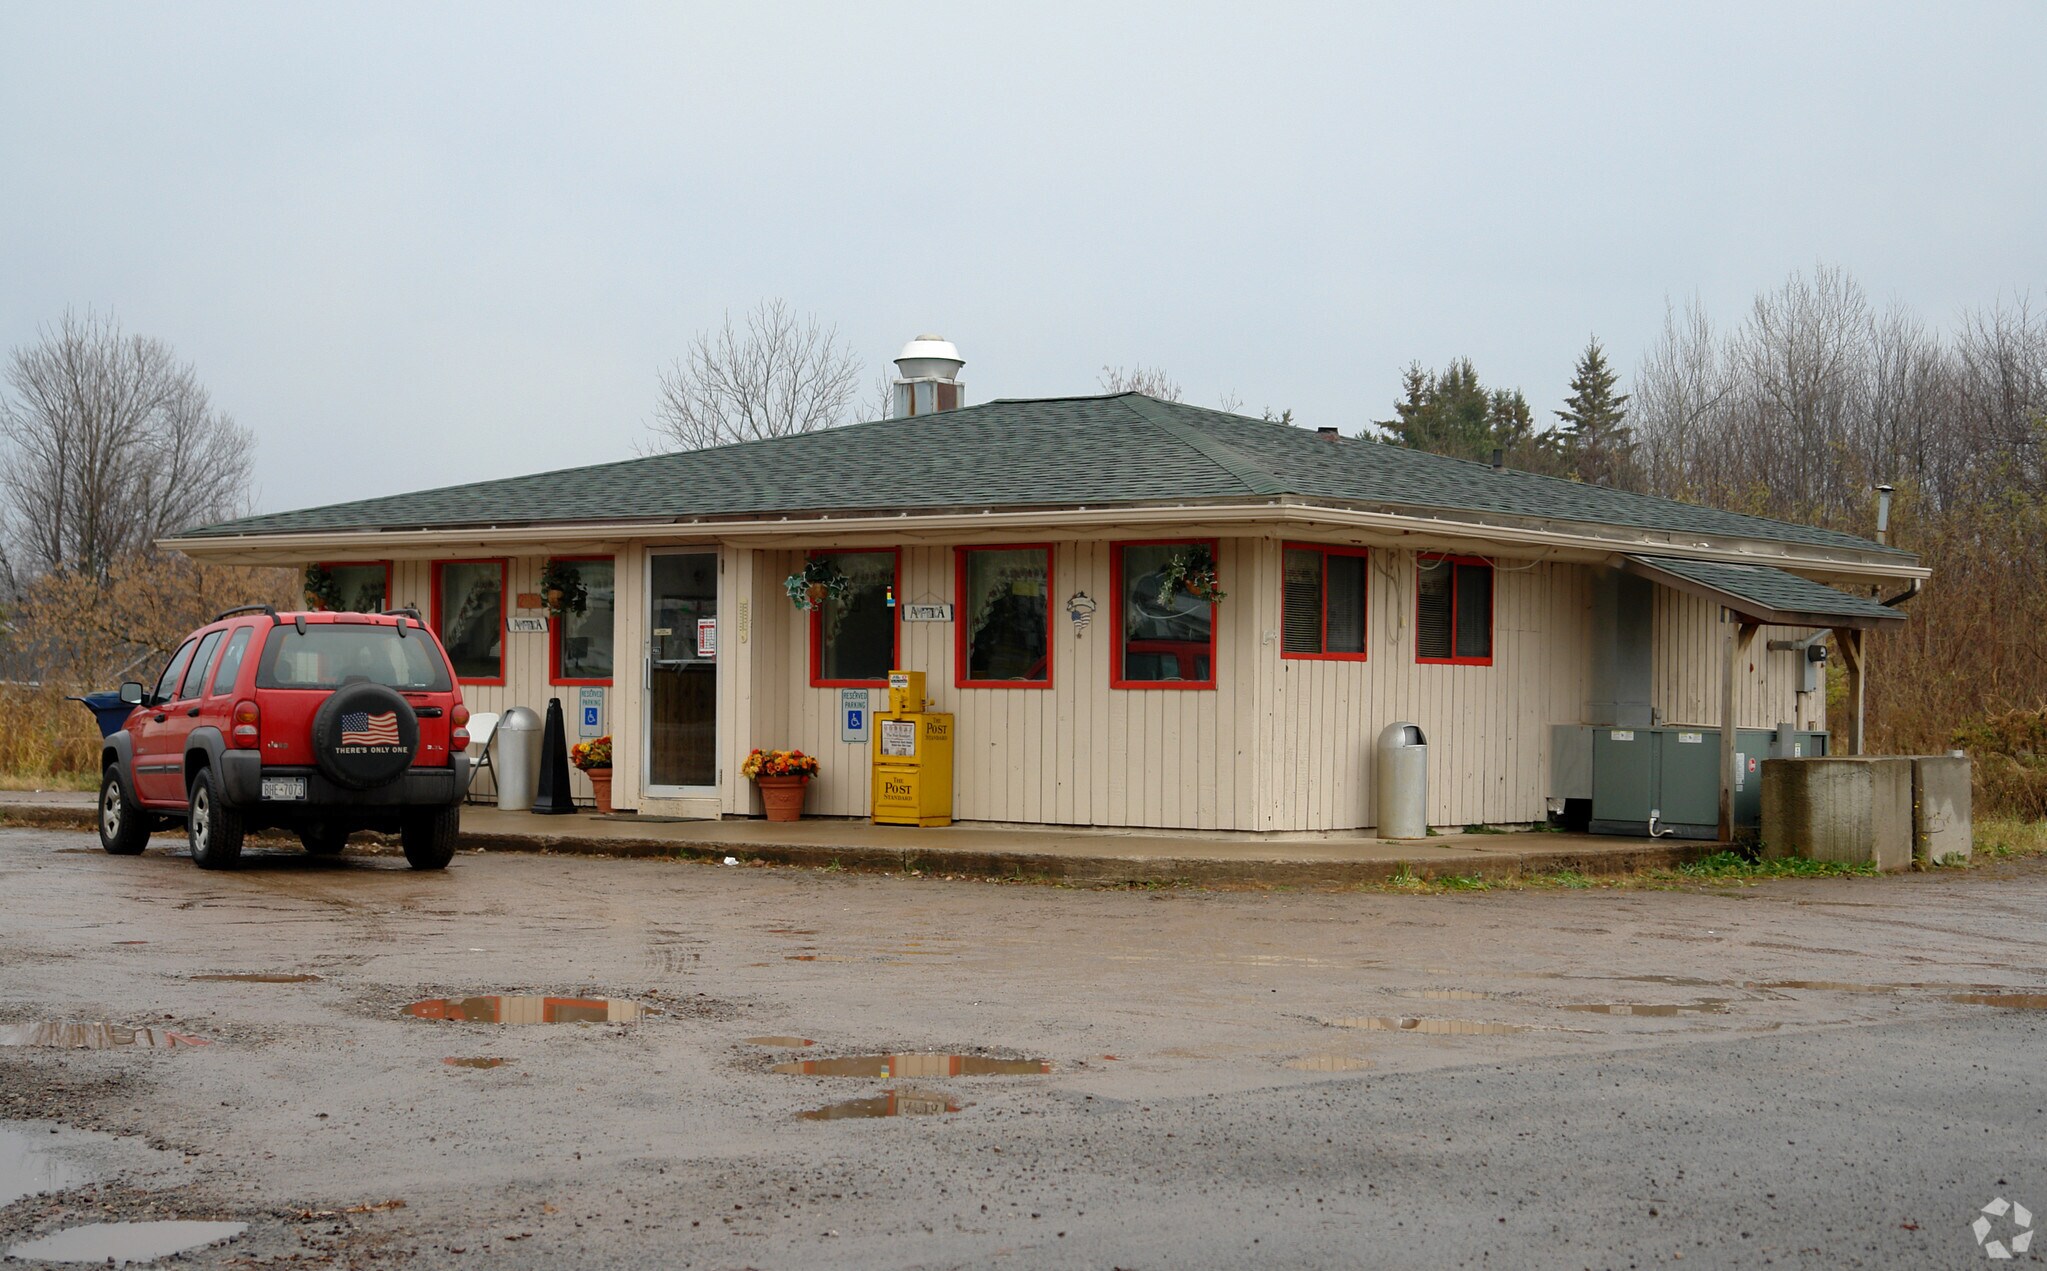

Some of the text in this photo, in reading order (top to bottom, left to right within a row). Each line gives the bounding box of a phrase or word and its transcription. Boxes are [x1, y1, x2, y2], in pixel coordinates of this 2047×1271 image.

[581, 690, 602, 698] RESERVED
[843, 691, 867, 700] RESERVED
[844, 701, 866, 709] PARKING
[926, 722, 948, 734] POST
[370, 746, 390, 754] ONLY
[885, 782, 912, 795] POST
